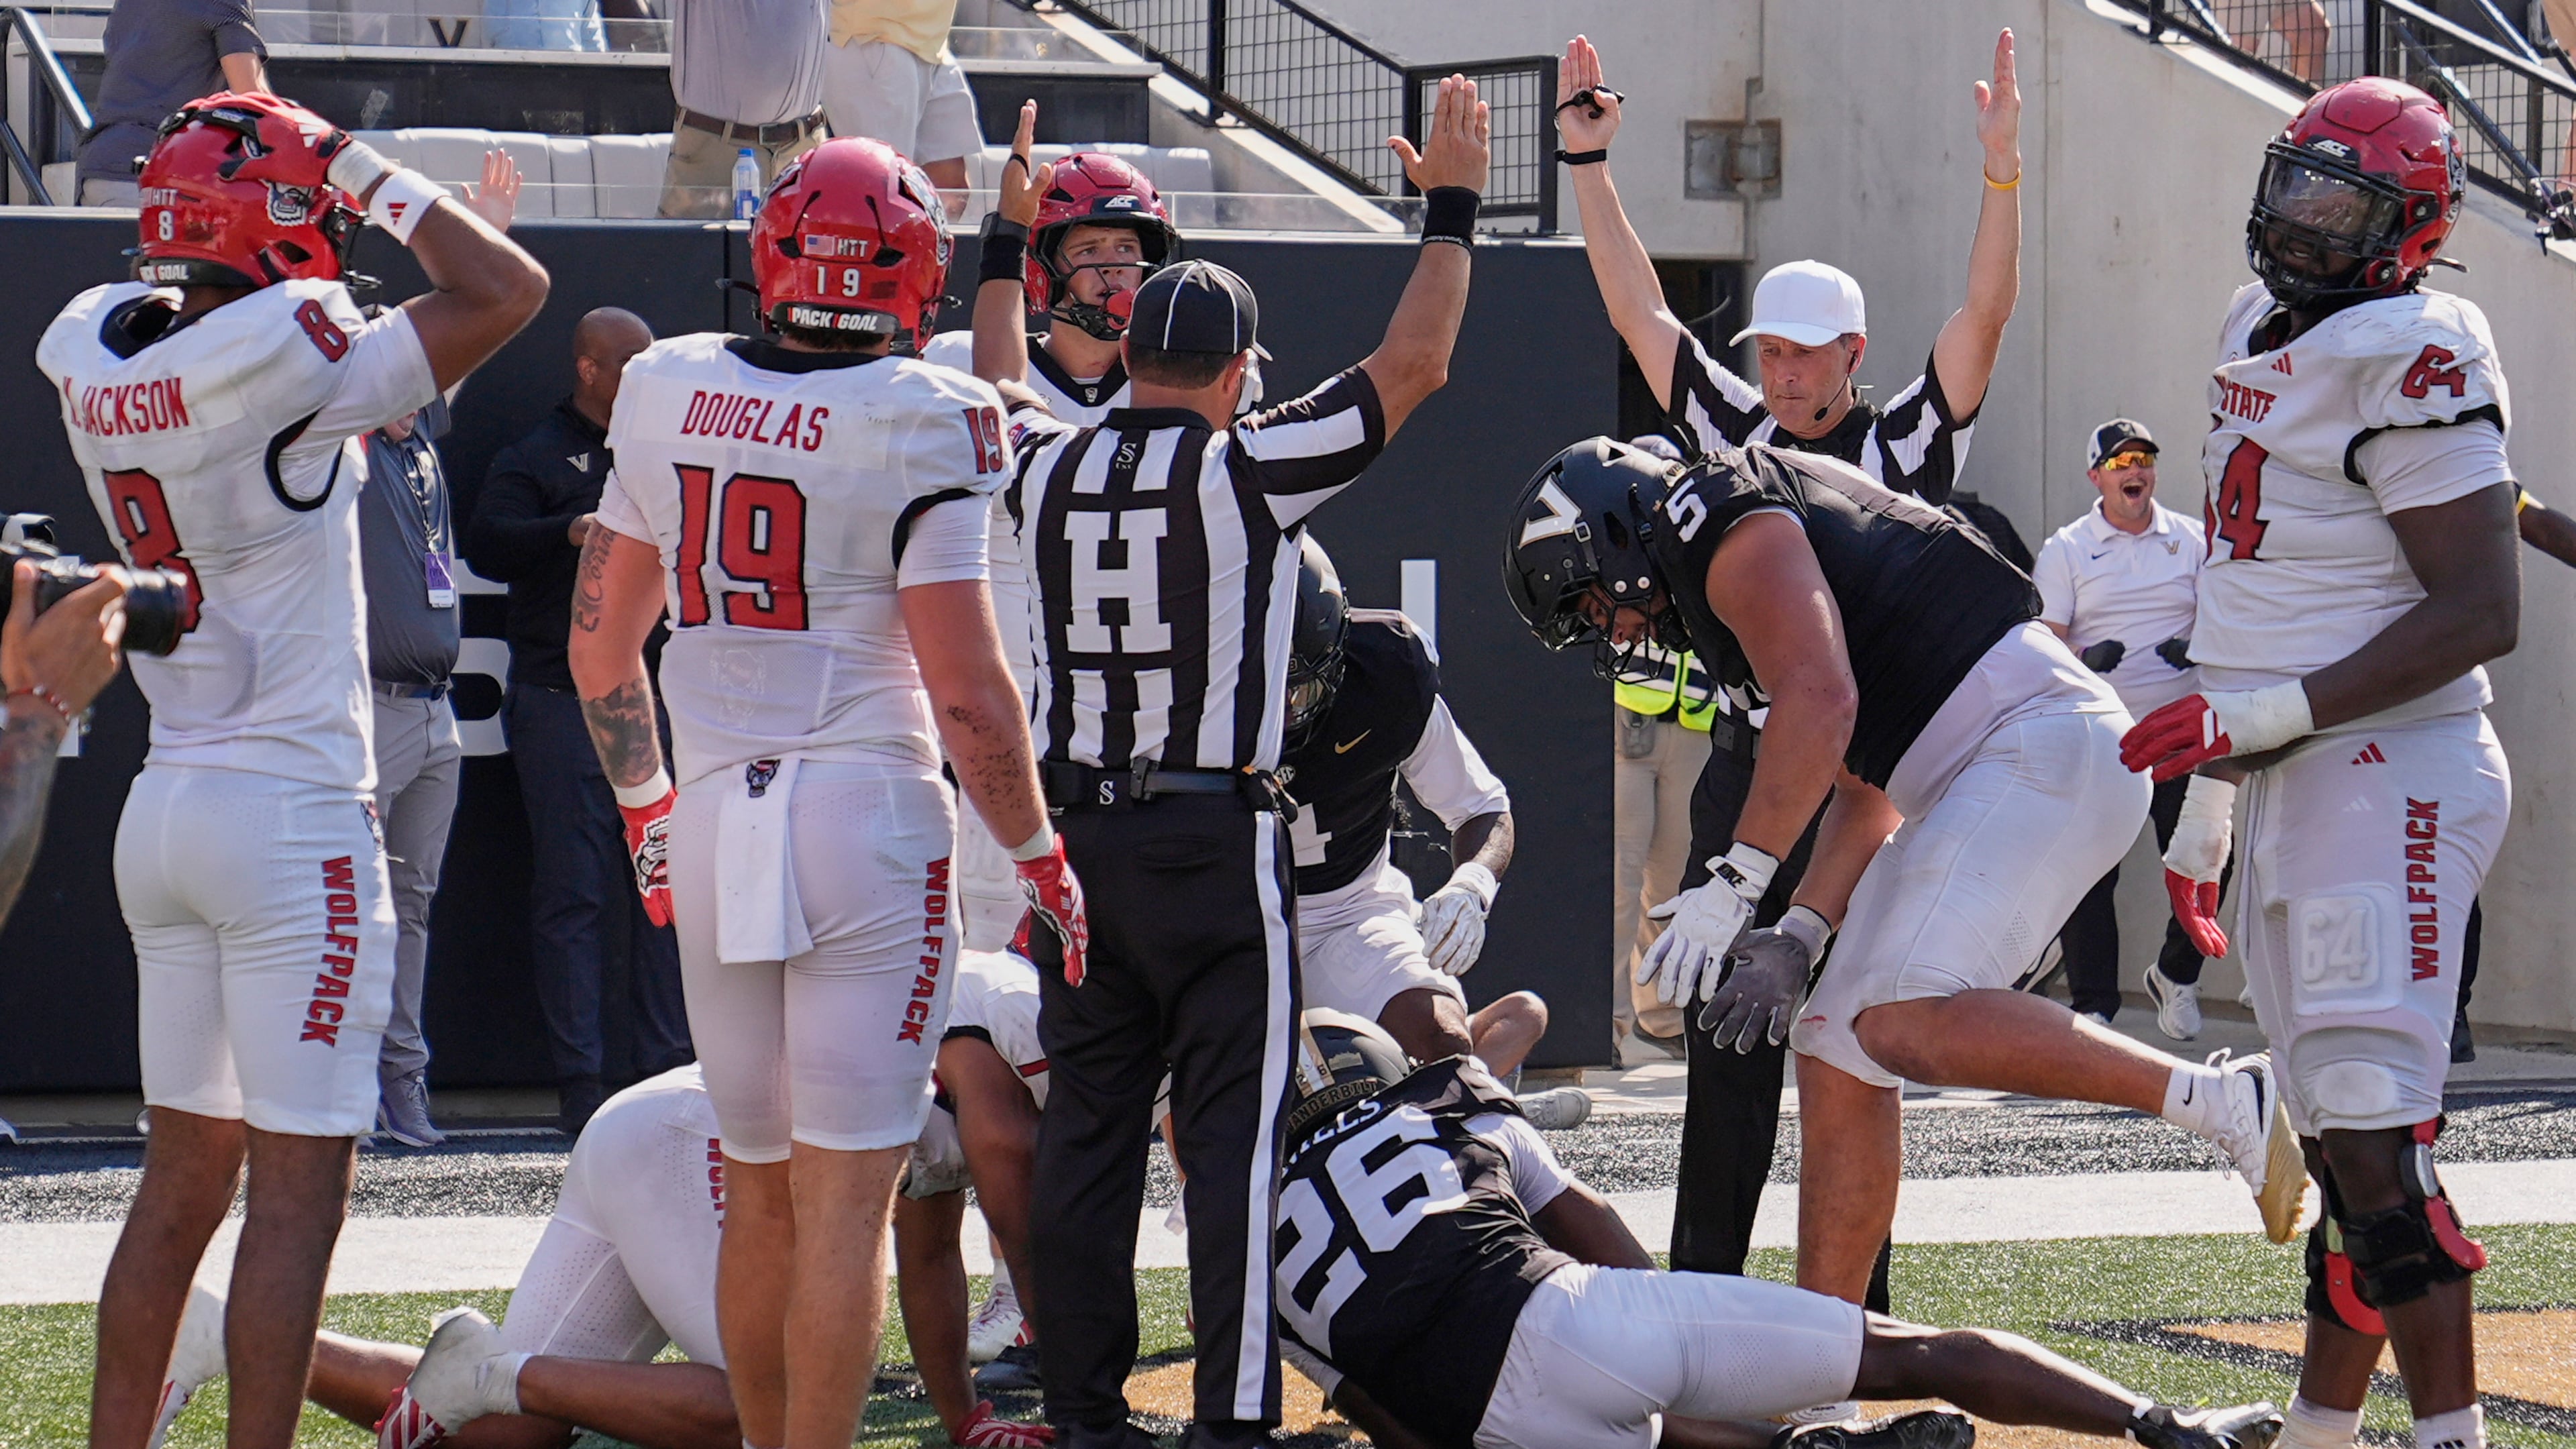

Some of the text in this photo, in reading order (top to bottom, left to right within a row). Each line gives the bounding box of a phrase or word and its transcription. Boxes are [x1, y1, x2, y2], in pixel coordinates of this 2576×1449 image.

[158, 210, 174, 241] 8
[1104, 195, 1139, 208] ACC
[838, 237, 869, 258] HTT
[292, 299, 349, 364] 8
[2401, 343, 2467, 399] 64
[82, 376, 190, 437] JACKSON
[680, 390, 829, 451] DOUGLAS
[963, 405, 1003, 474] 19
[1518, 474, 1582, 549] V
[1665, 477, 1708, 543] 5
[672, 462, 810, 631] 19
[1063, 506, 1173, 654] H
[1099, 780, 1115, 805] S
[2405, 796, 2440, 983] WOLFPACK
[299, 854, 359, 1049] WOLFPACK
[896, 855, 951, 1046] WOLFPACK
[2300, 908, 2372, 985] 64
[1275, 1104, 1470, 1360] 26
